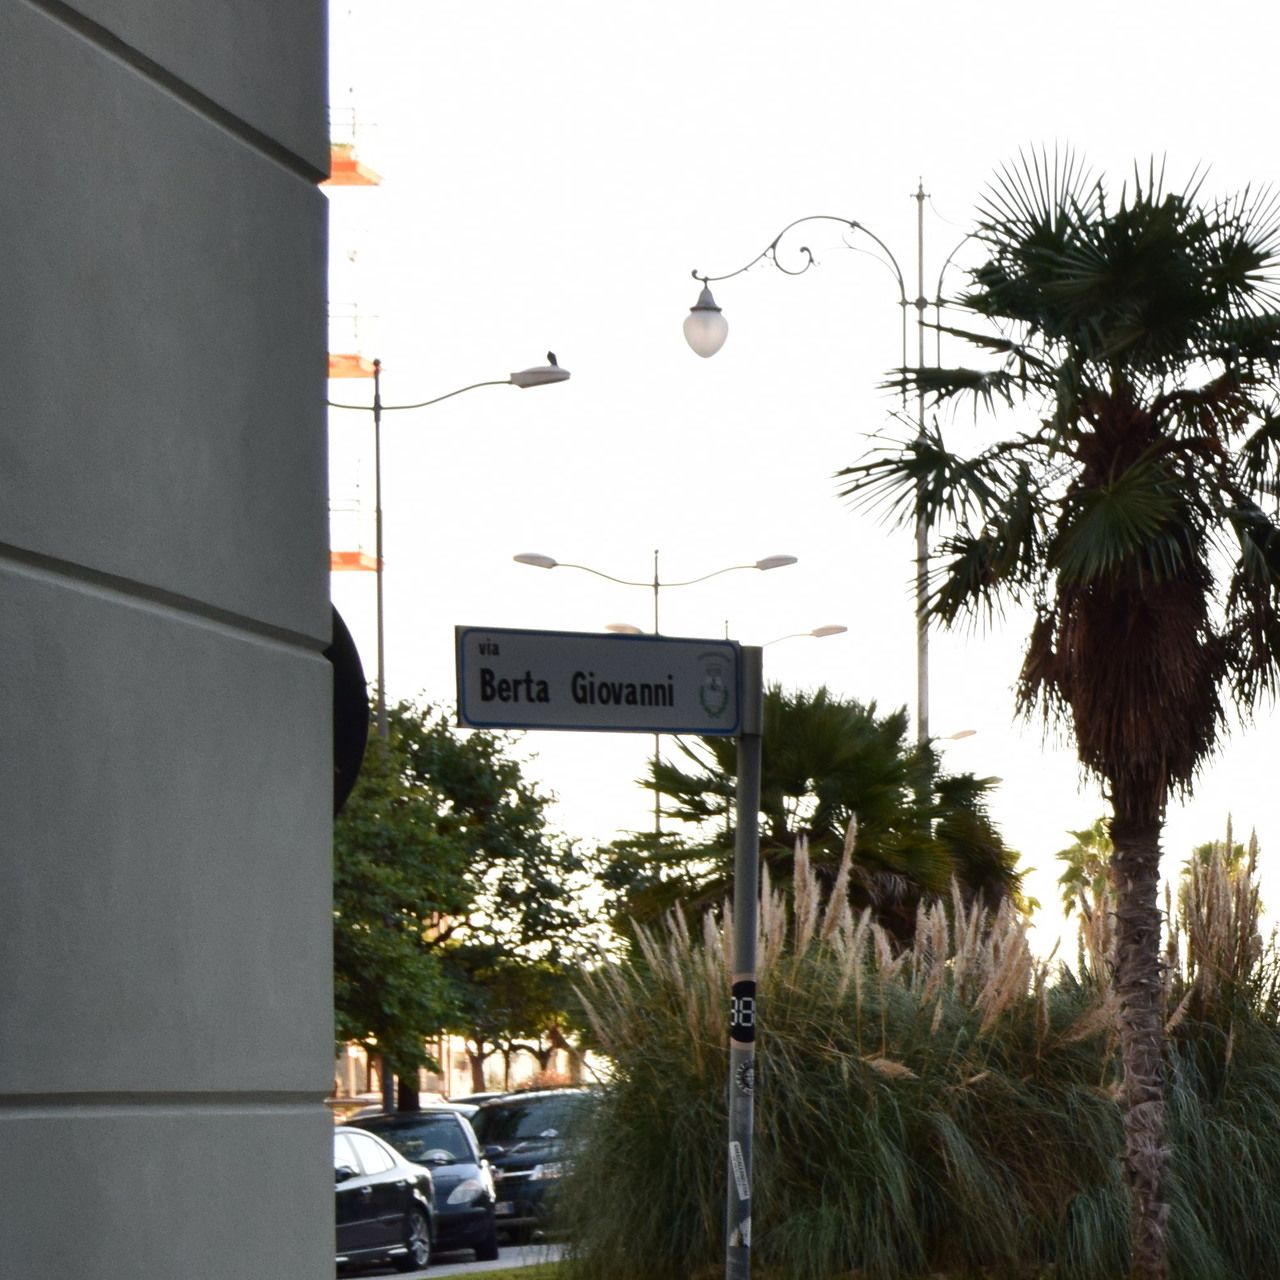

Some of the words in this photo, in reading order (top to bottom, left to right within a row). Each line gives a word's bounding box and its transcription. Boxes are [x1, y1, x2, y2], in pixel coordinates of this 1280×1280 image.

[479, 637, 500, 656] via
[480, 667, 550, 703] Berta
[571, 671, 675, 707] Giovanni
